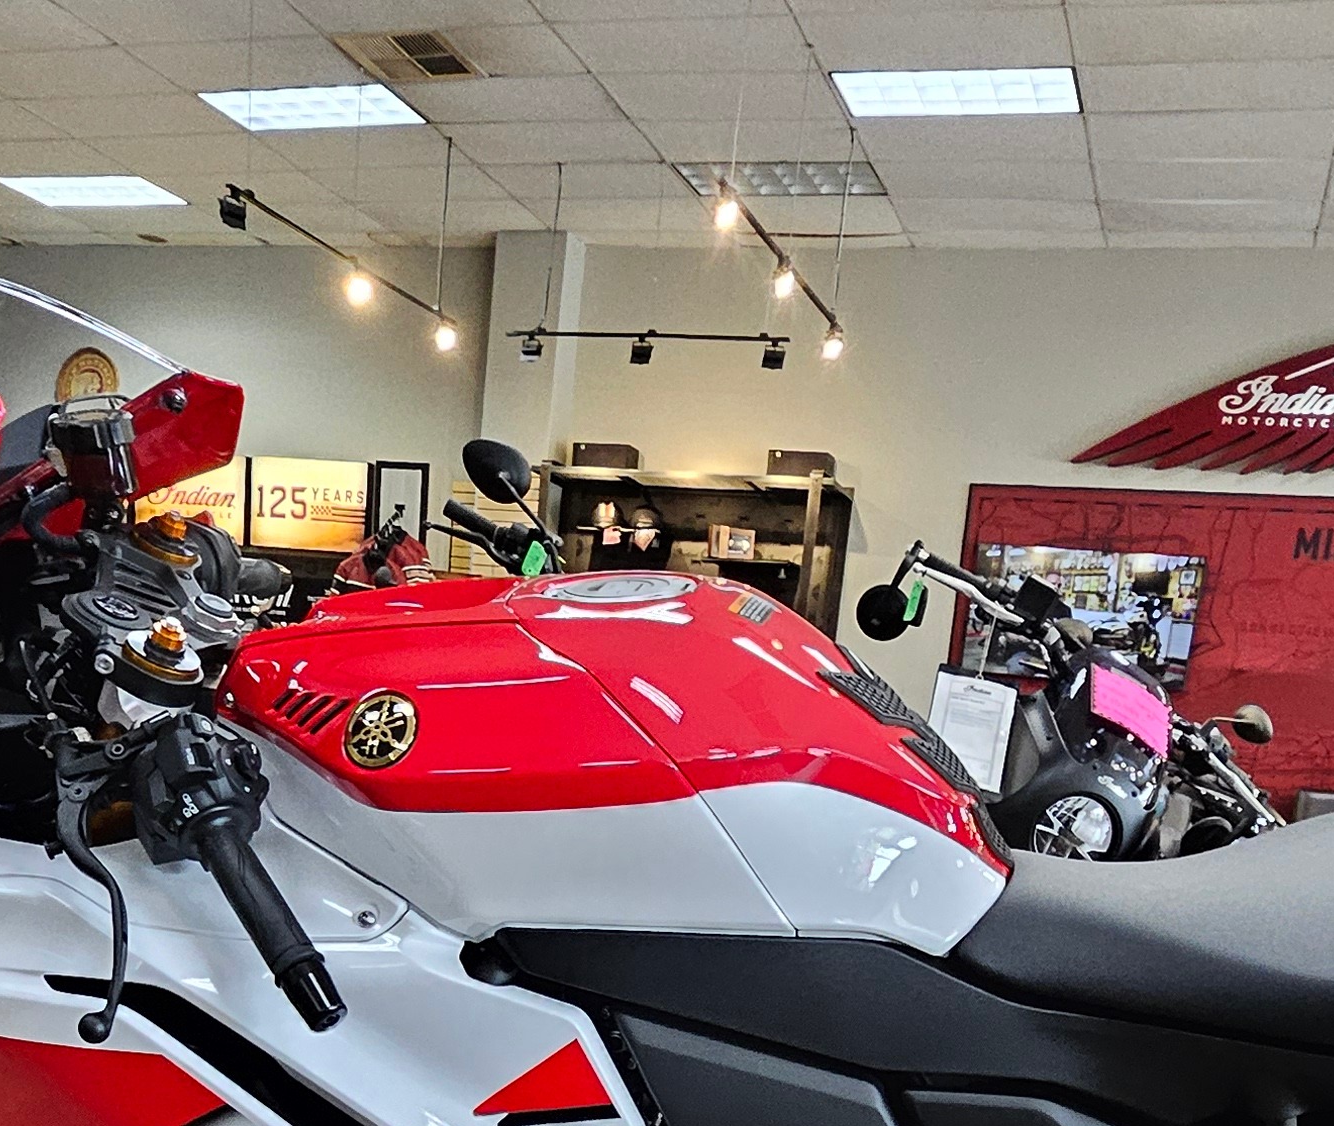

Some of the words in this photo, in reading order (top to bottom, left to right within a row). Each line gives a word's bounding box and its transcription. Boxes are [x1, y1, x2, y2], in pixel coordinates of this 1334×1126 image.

[147, 485, 236, 508] Indian
[256, 484, 309, 520] 125
[311, 487, 365, 505] YEARS
